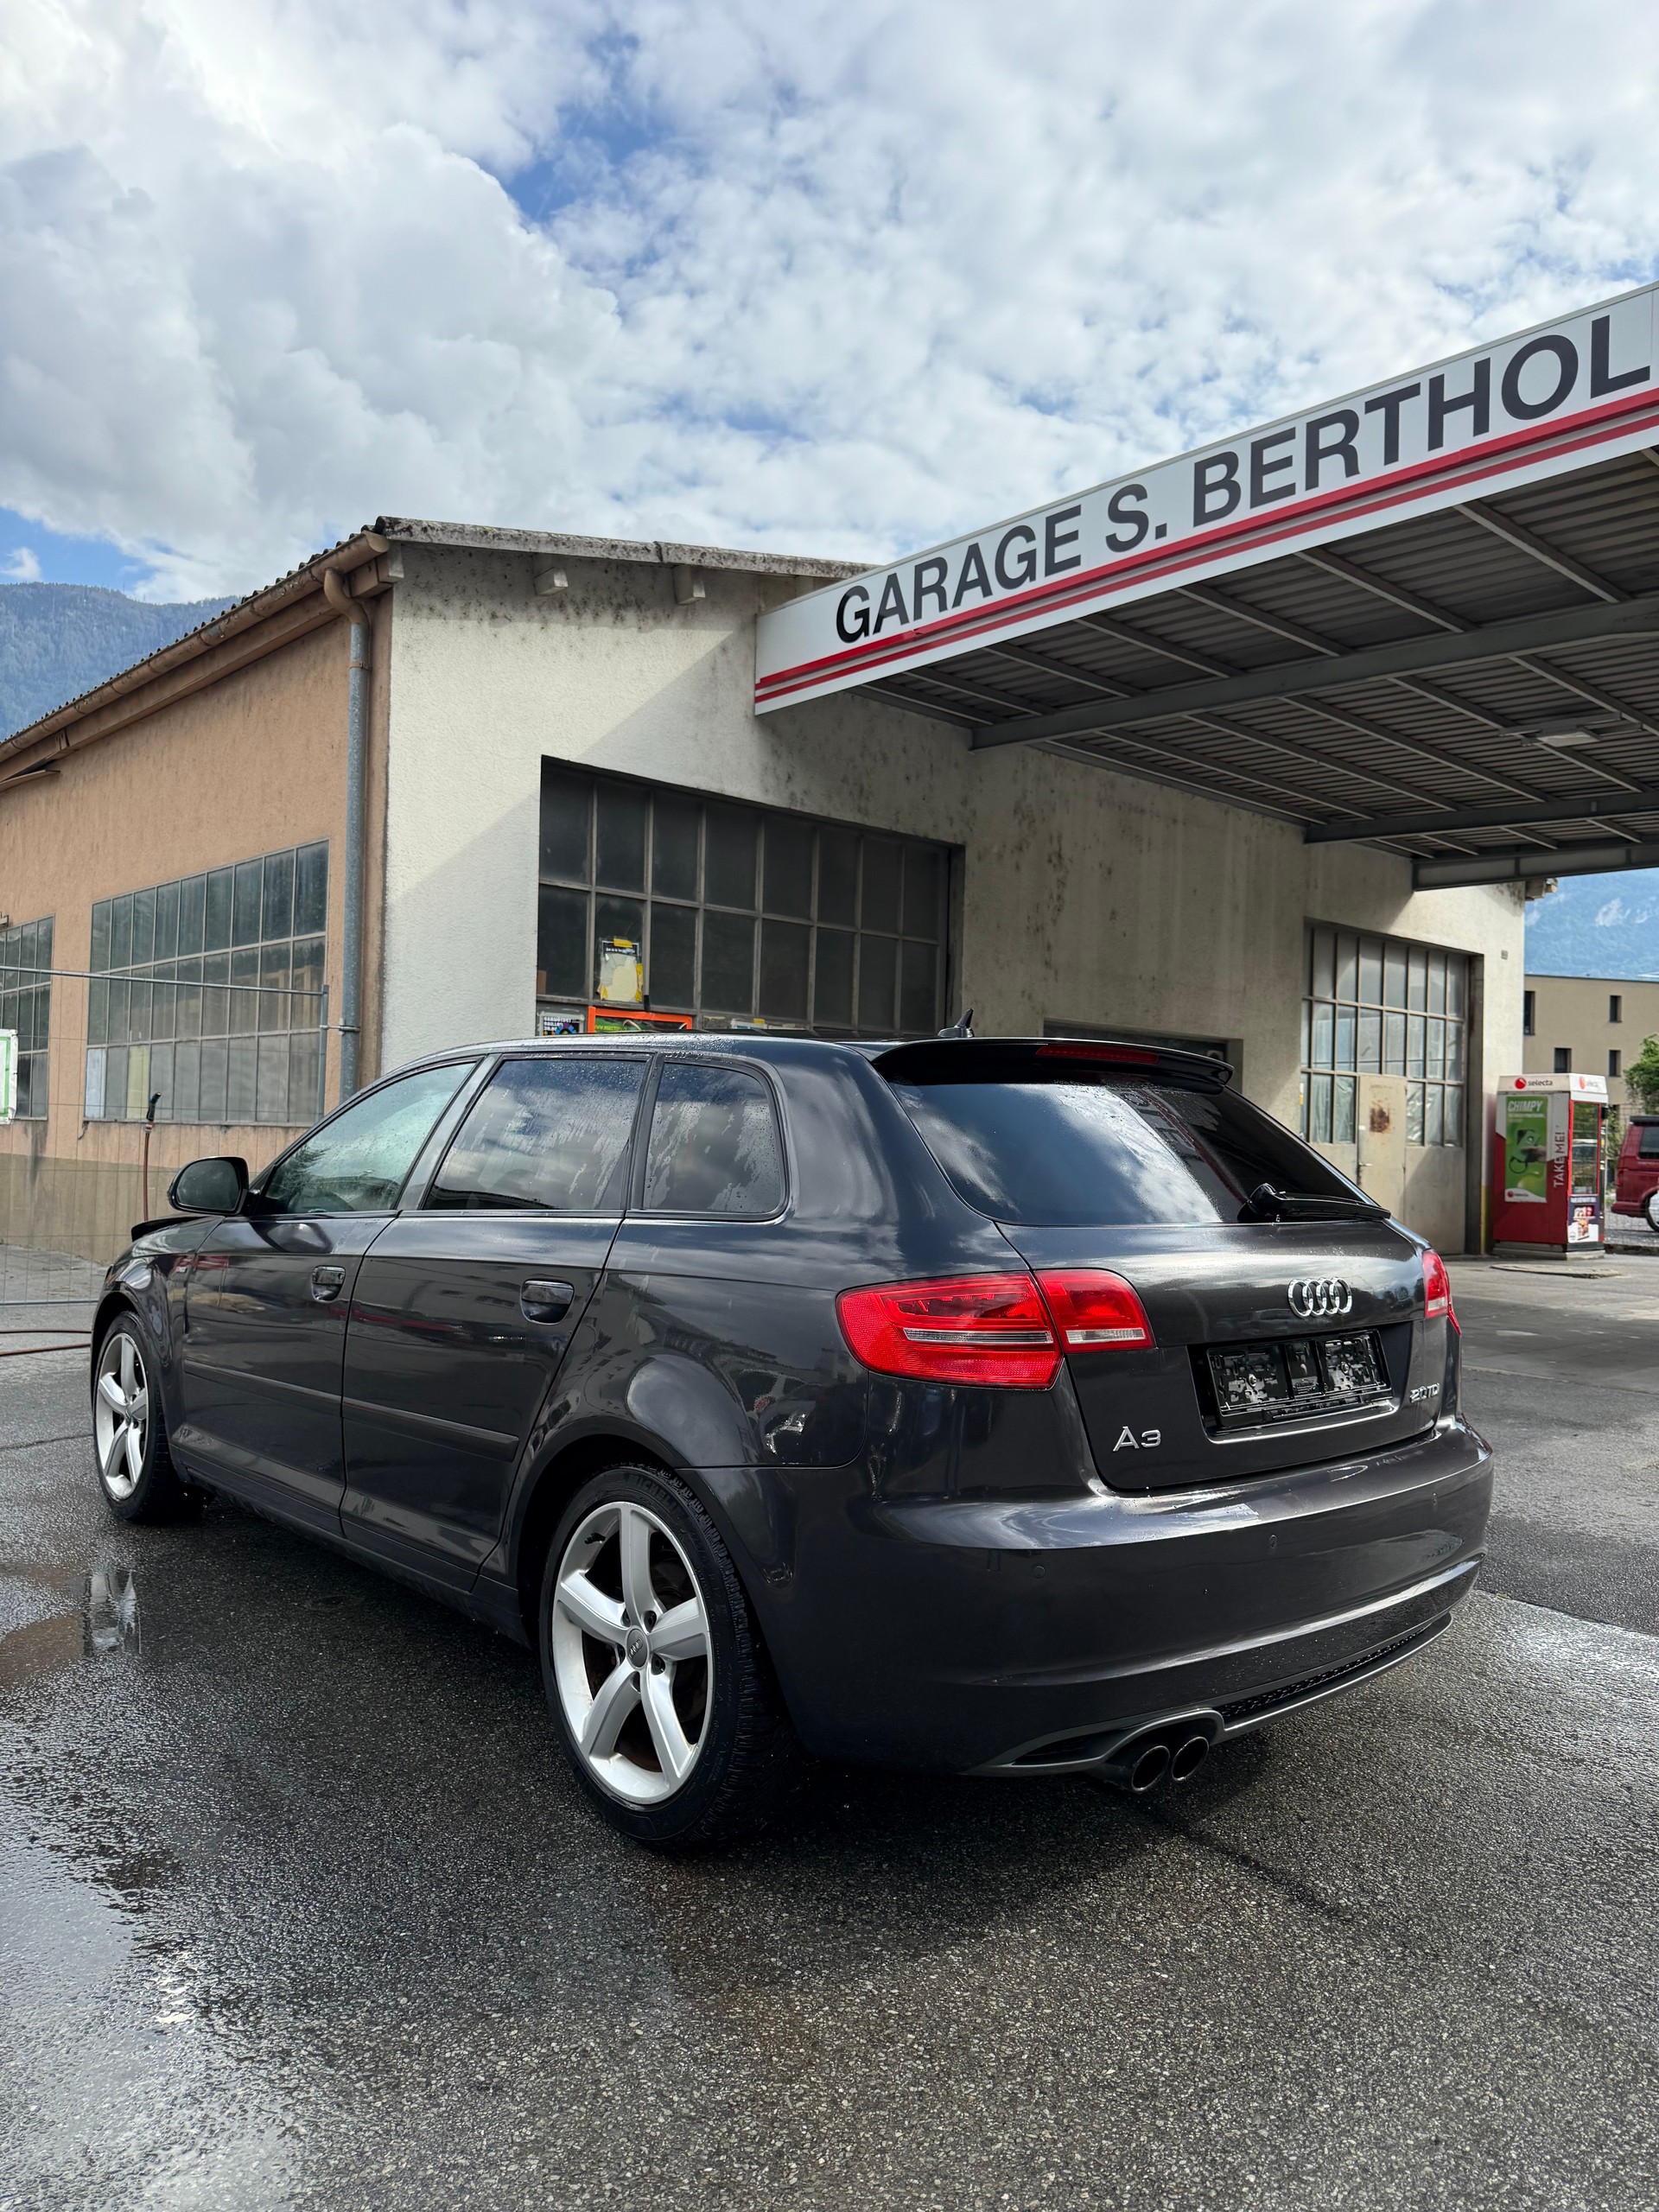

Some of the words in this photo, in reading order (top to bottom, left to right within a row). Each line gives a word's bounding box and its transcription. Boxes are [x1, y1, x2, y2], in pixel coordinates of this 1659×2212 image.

[836, 504, 1081, 644] GARAGE
[1106, 483, 1168, 553] S.
[1192, 315, 1650, 525] BERTHOL
[1507, 1100, 1542, 1112] CHIMPY
[1554, 1132, 1566, 1154] ME!
[1553, 1156, 1565, 1188] TAKE
[1113, 1426, 1161, 1452] A3
